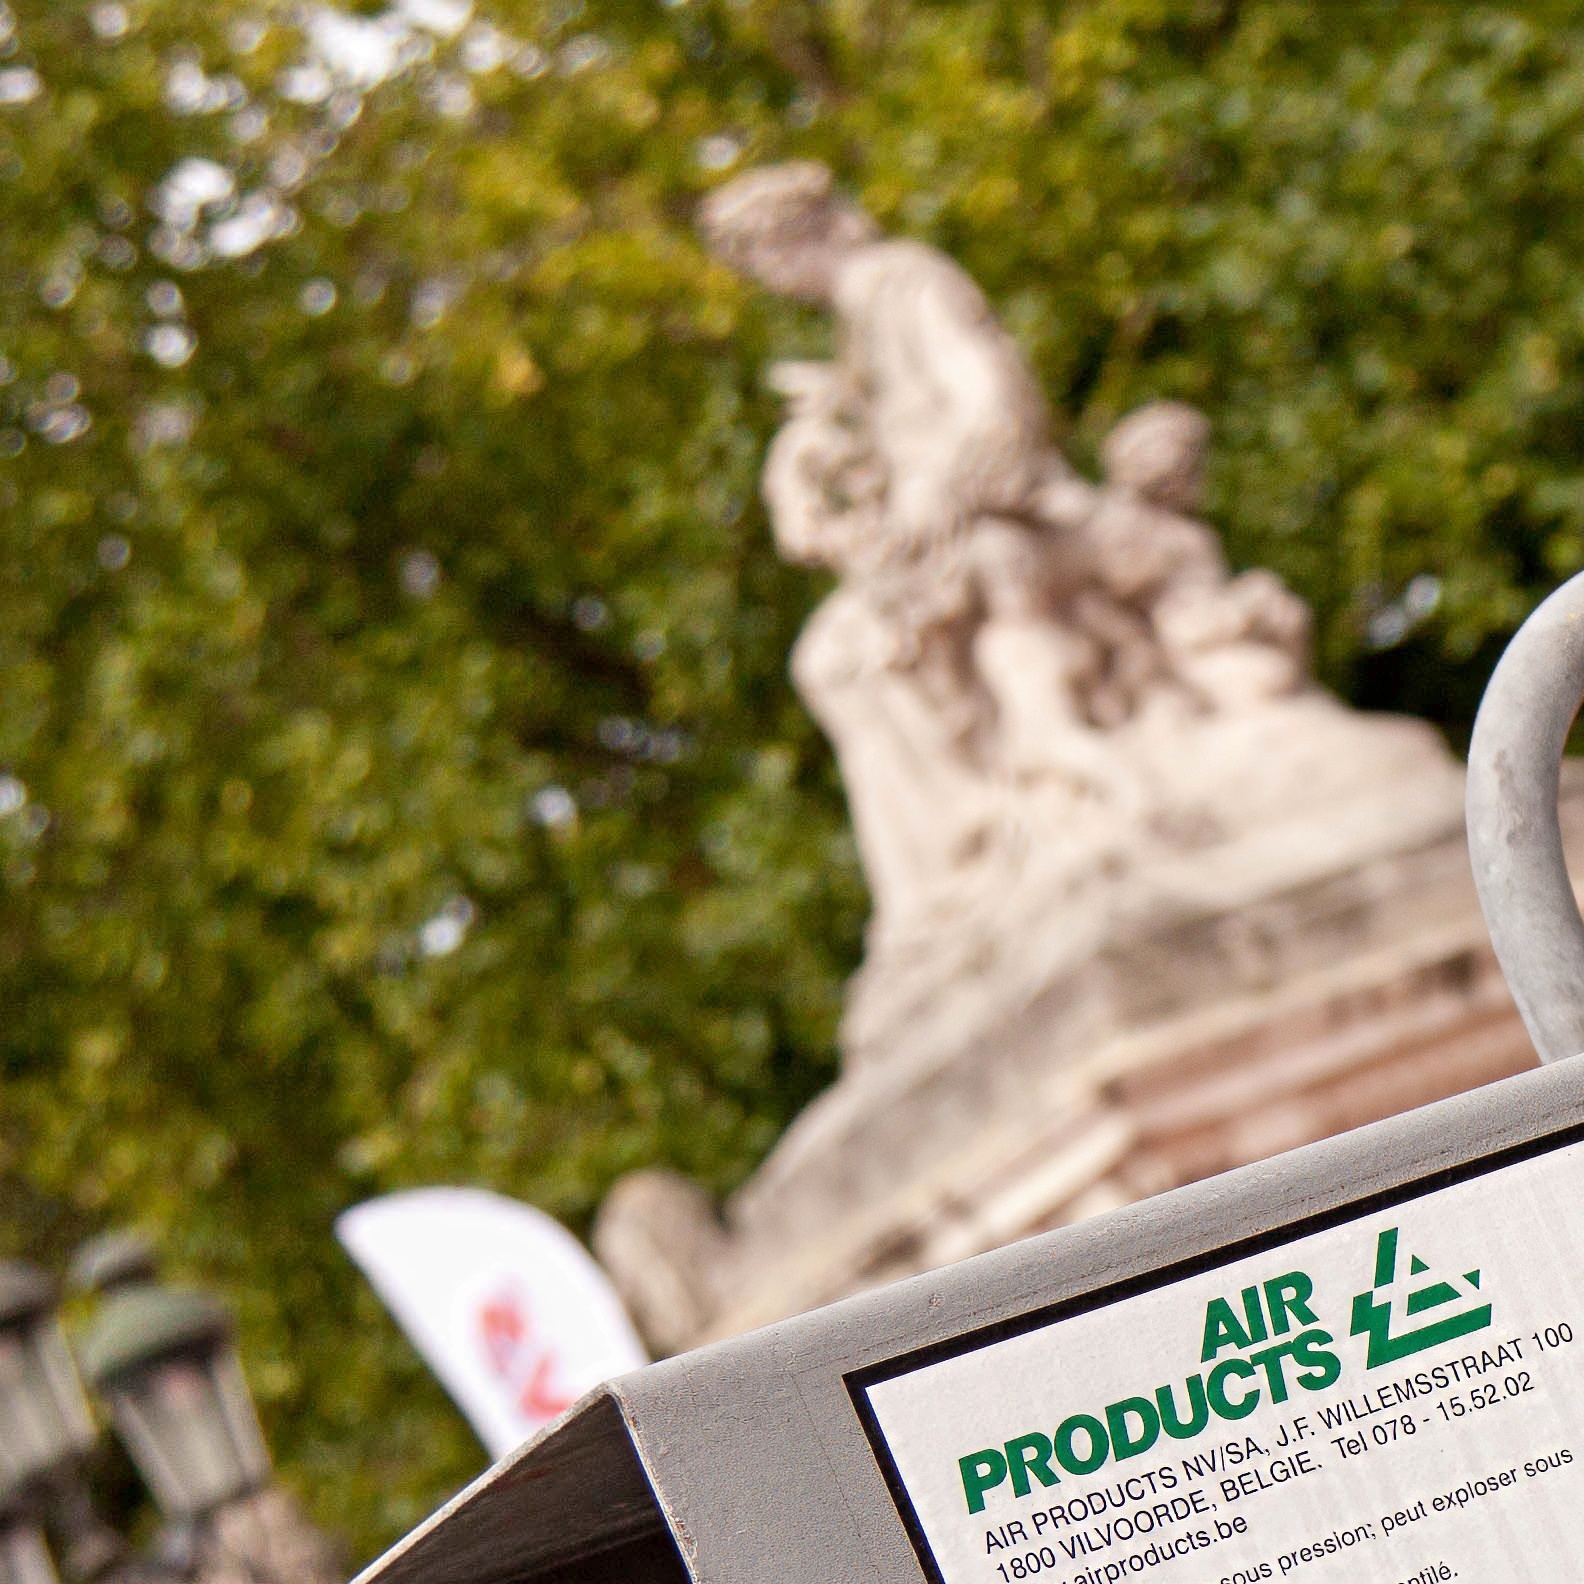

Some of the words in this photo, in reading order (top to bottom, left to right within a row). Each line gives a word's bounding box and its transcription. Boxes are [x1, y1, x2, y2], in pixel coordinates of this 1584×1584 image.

[1200, 1270, 1320, 1364] AIR
[957, 1328, 1342, 1515] PRODUCTS
[984, 1519, 1030, 1556] AIR
[1030, 1465, 1179, 1537] PRODUCTS
[1180, 1435, 1272, 1483] NV/SA,
[1275, 1415, 1317, 1448] J.F.
[1315, 1336, 1524, 1431] WILLEMSSTRAAT
[1530, 1321, 1574, 1353] 100
[995, 1545, 1057, 1584] 1800
[1056, 1488, 1219, 1561] VILVOORDE,
[1218, 1449, 1324, 1504] BELGIE.
[1329, 1429, 1370, 1460] Tel
[1370, 1413, 1418, 1447] 078
[1435, 1370, 1536, 1423] 15.52.02
[1276, 1522, 1378, 1578] pression;
[1379, 1499, 1429, 1539] peut
[1430, 1467, 1518, 1513] exploser
[1522, 1448, 1575, 1479] sous
